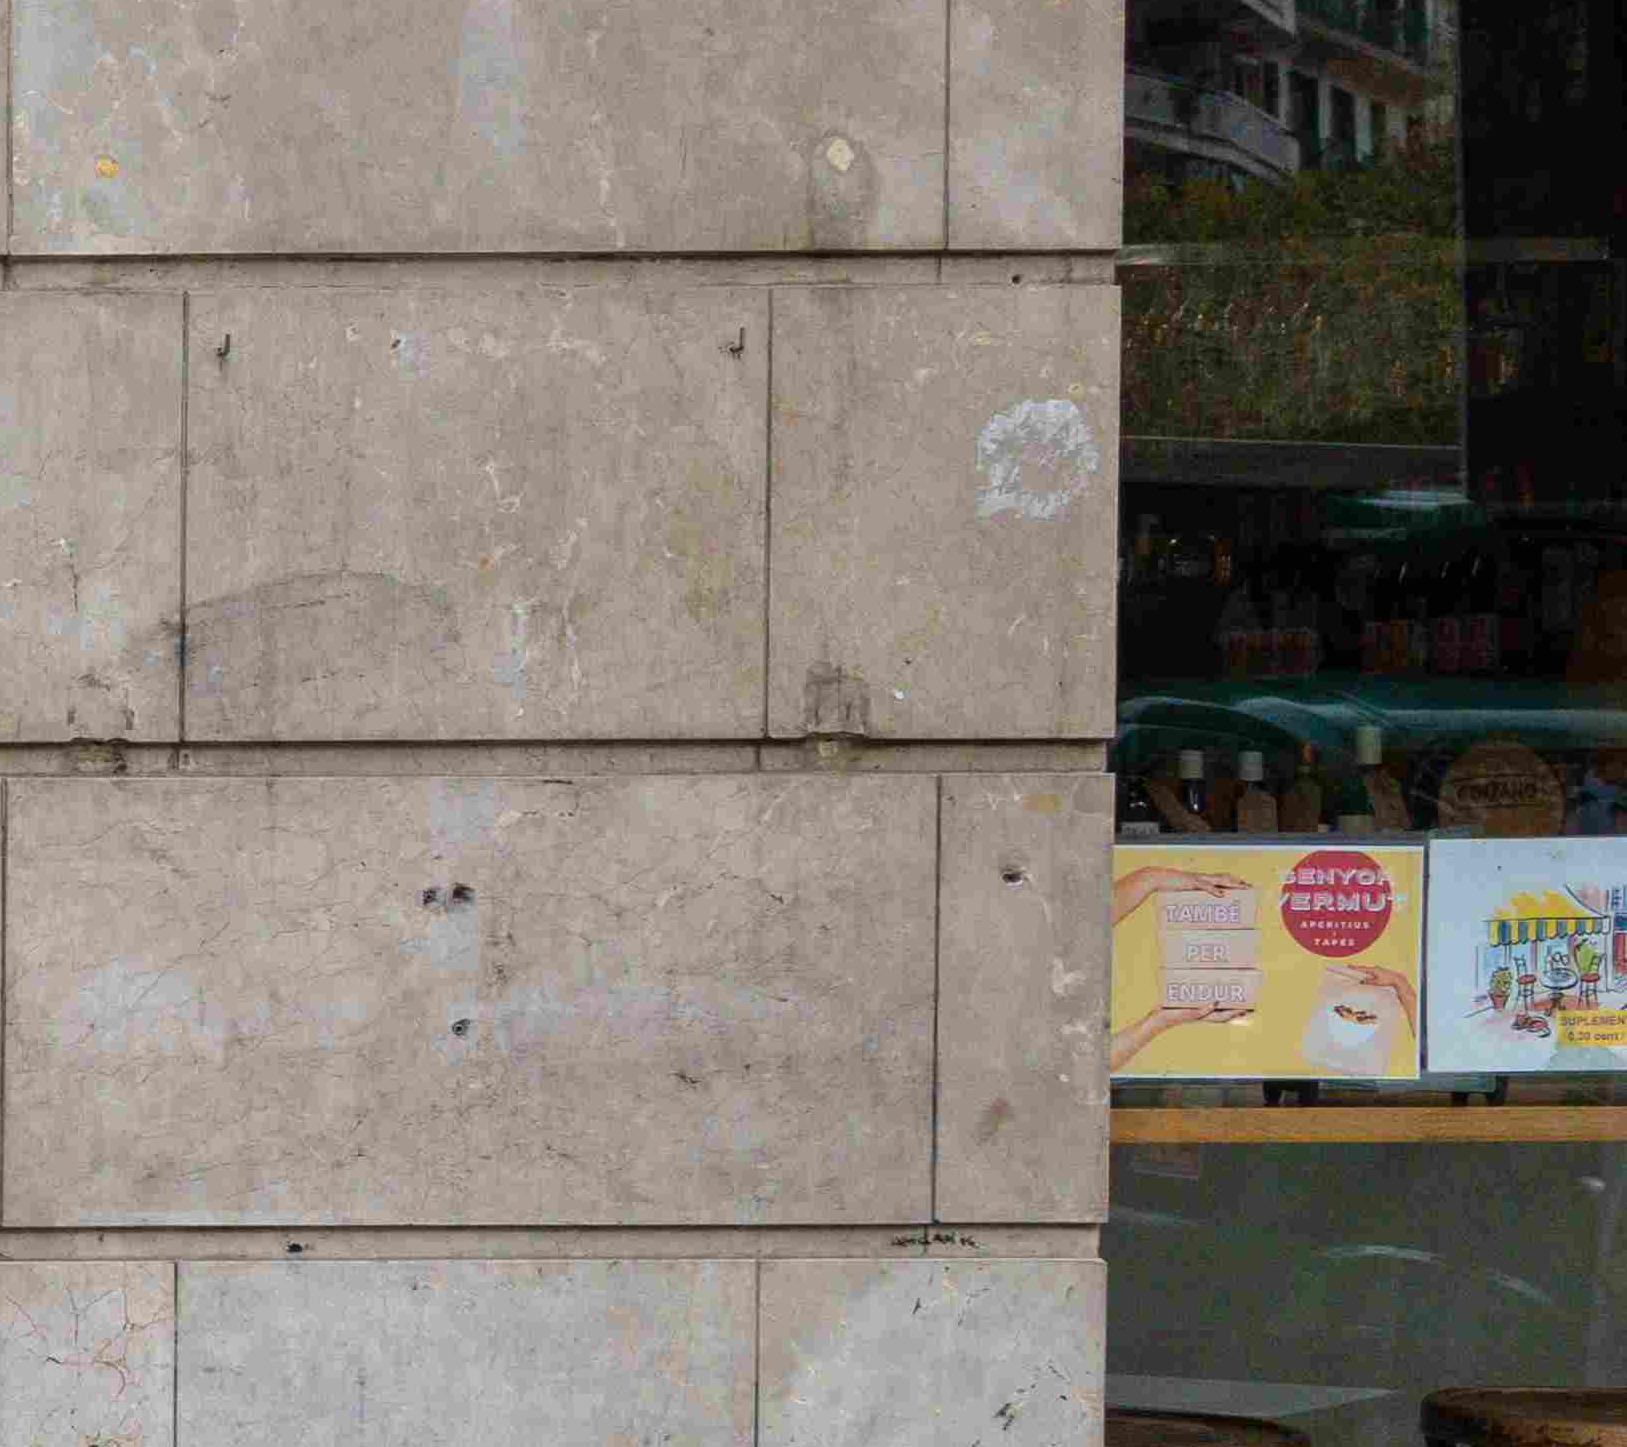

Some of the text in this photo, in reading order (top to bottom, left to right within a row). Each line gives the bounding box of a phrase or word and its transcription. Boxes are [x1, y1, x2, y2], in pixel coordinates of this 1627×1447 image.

[1165, 901, 1241, 925] TAMBÉ
[1184, 944, 1225, 963] PER
[1165, 984, 1246, 1004] ENDUR
